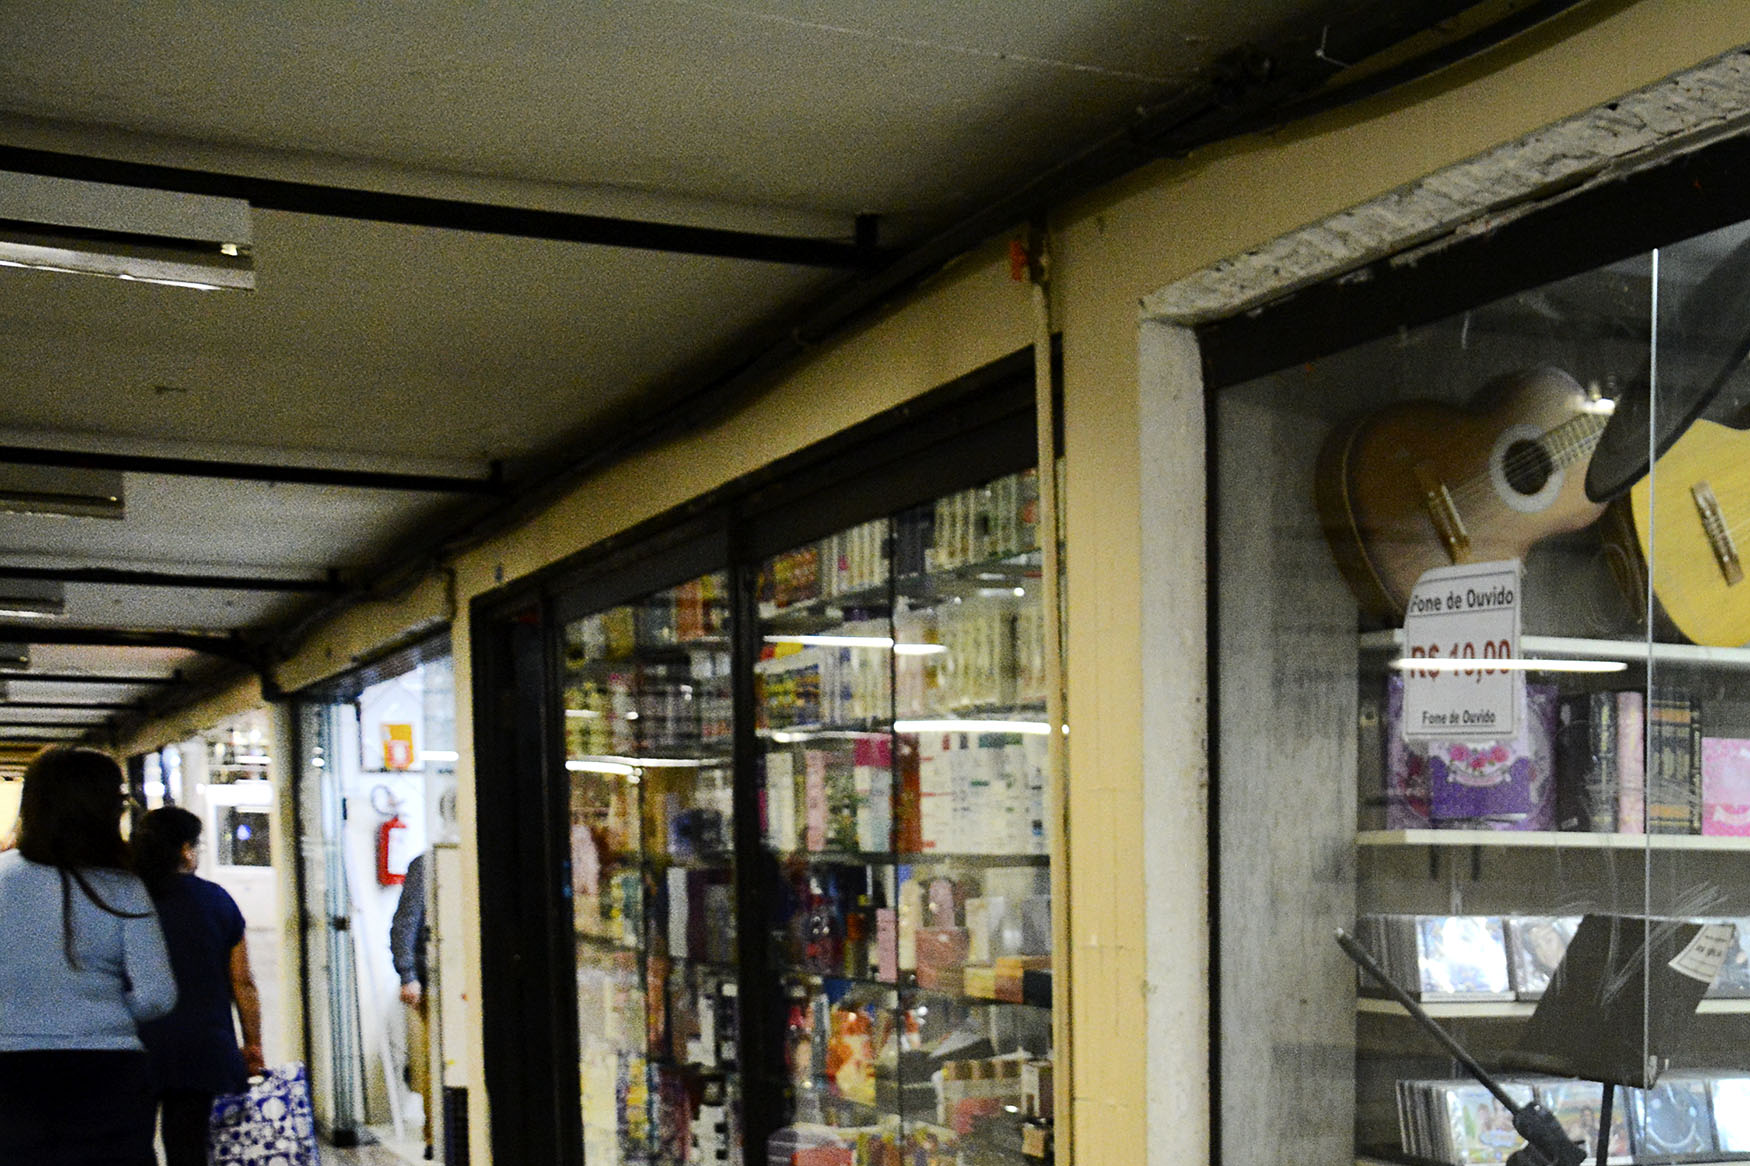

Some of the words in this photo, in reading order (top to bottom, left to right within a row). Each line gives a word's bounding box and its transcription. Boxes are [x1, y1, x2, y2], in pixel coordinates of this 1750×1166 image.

[1410, 595, 1442, 613] Fone
[1447, 591, 1462, 609] de
[1467, 586, 1514, 608] Ouvido
[1411, 643, 1439, 682] R$
[1422, 710, 1447, 725] Fone
[1449, 710, 1460, 724] de
[1462, 709, 1496, 724] Ouvido
